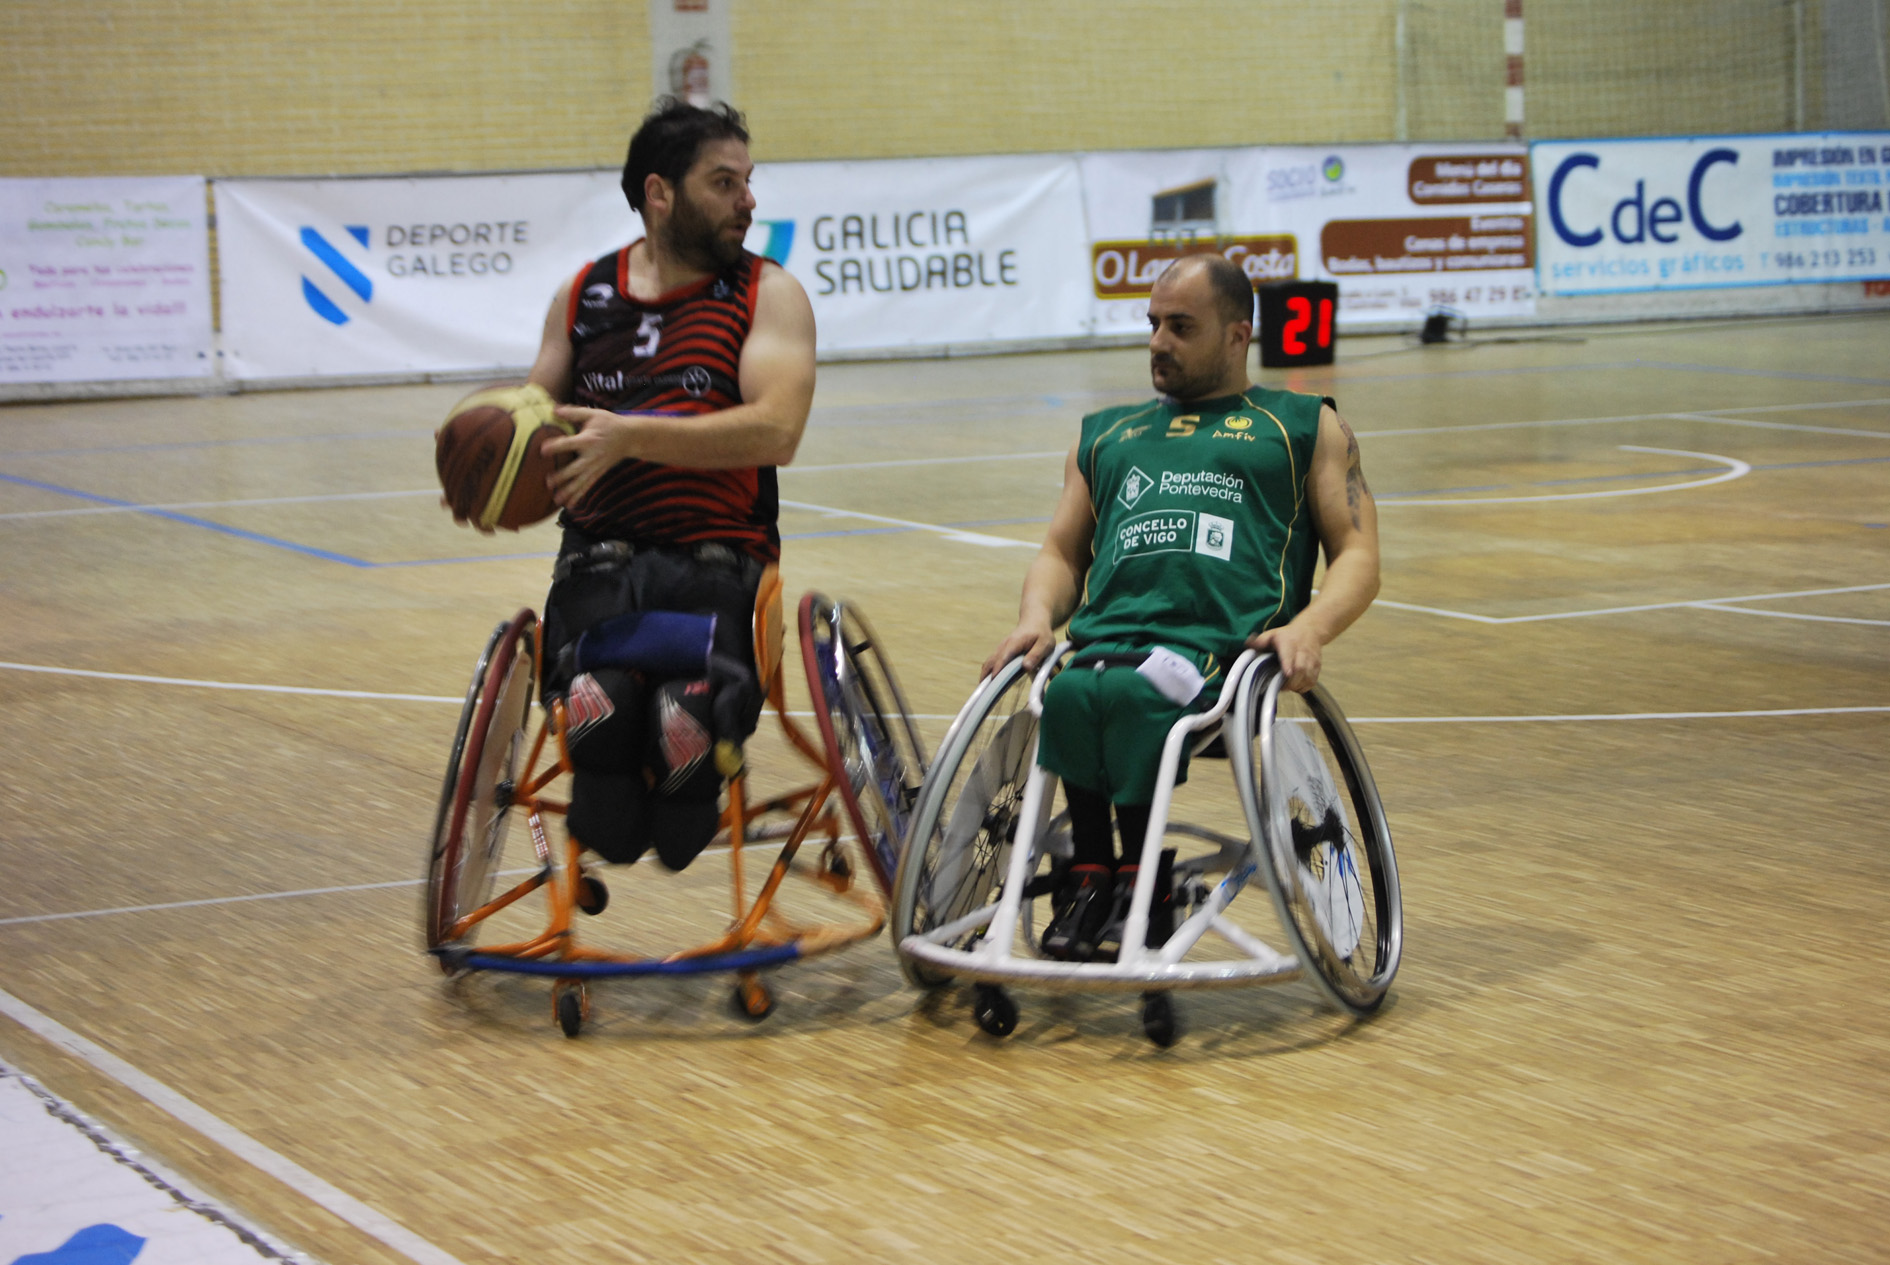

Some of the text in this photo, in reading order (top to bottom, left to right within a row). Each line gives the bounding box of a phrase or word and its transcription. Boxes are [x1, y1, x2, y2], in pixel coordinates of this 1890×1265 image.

[1858, 146, 1876, 164] EN
[1774, 191, 1882, 216] COBERTURA
[386, 220, 529, 248] DEPORTE
[813, 209, 969, 252] GALICIA
[386, 251, 513, 277] GALEGO
[1552, 251, 1745, 279] servicios gráficos
[1775, 251, 1804, 268] 986
[1810, 249, 1840, 267] 213
[1847, 248, 1876, 266] 253
[815, 250, 1018, 296] SAUDABLE
[632, 312, 663, 358] 5
[1282, 296, 1333, 355] 21
[582, 370, 624, 392] Vital
[1212, 429, 1256, 442] Amfiv
[1159, 482, 1243, 503] Pontevedra
[1160, 470, 1244, 491] Deputación
[1120, 517, 1188, 541] CONCELLO
[1123, 530, 1178, 550] DE VIGO
